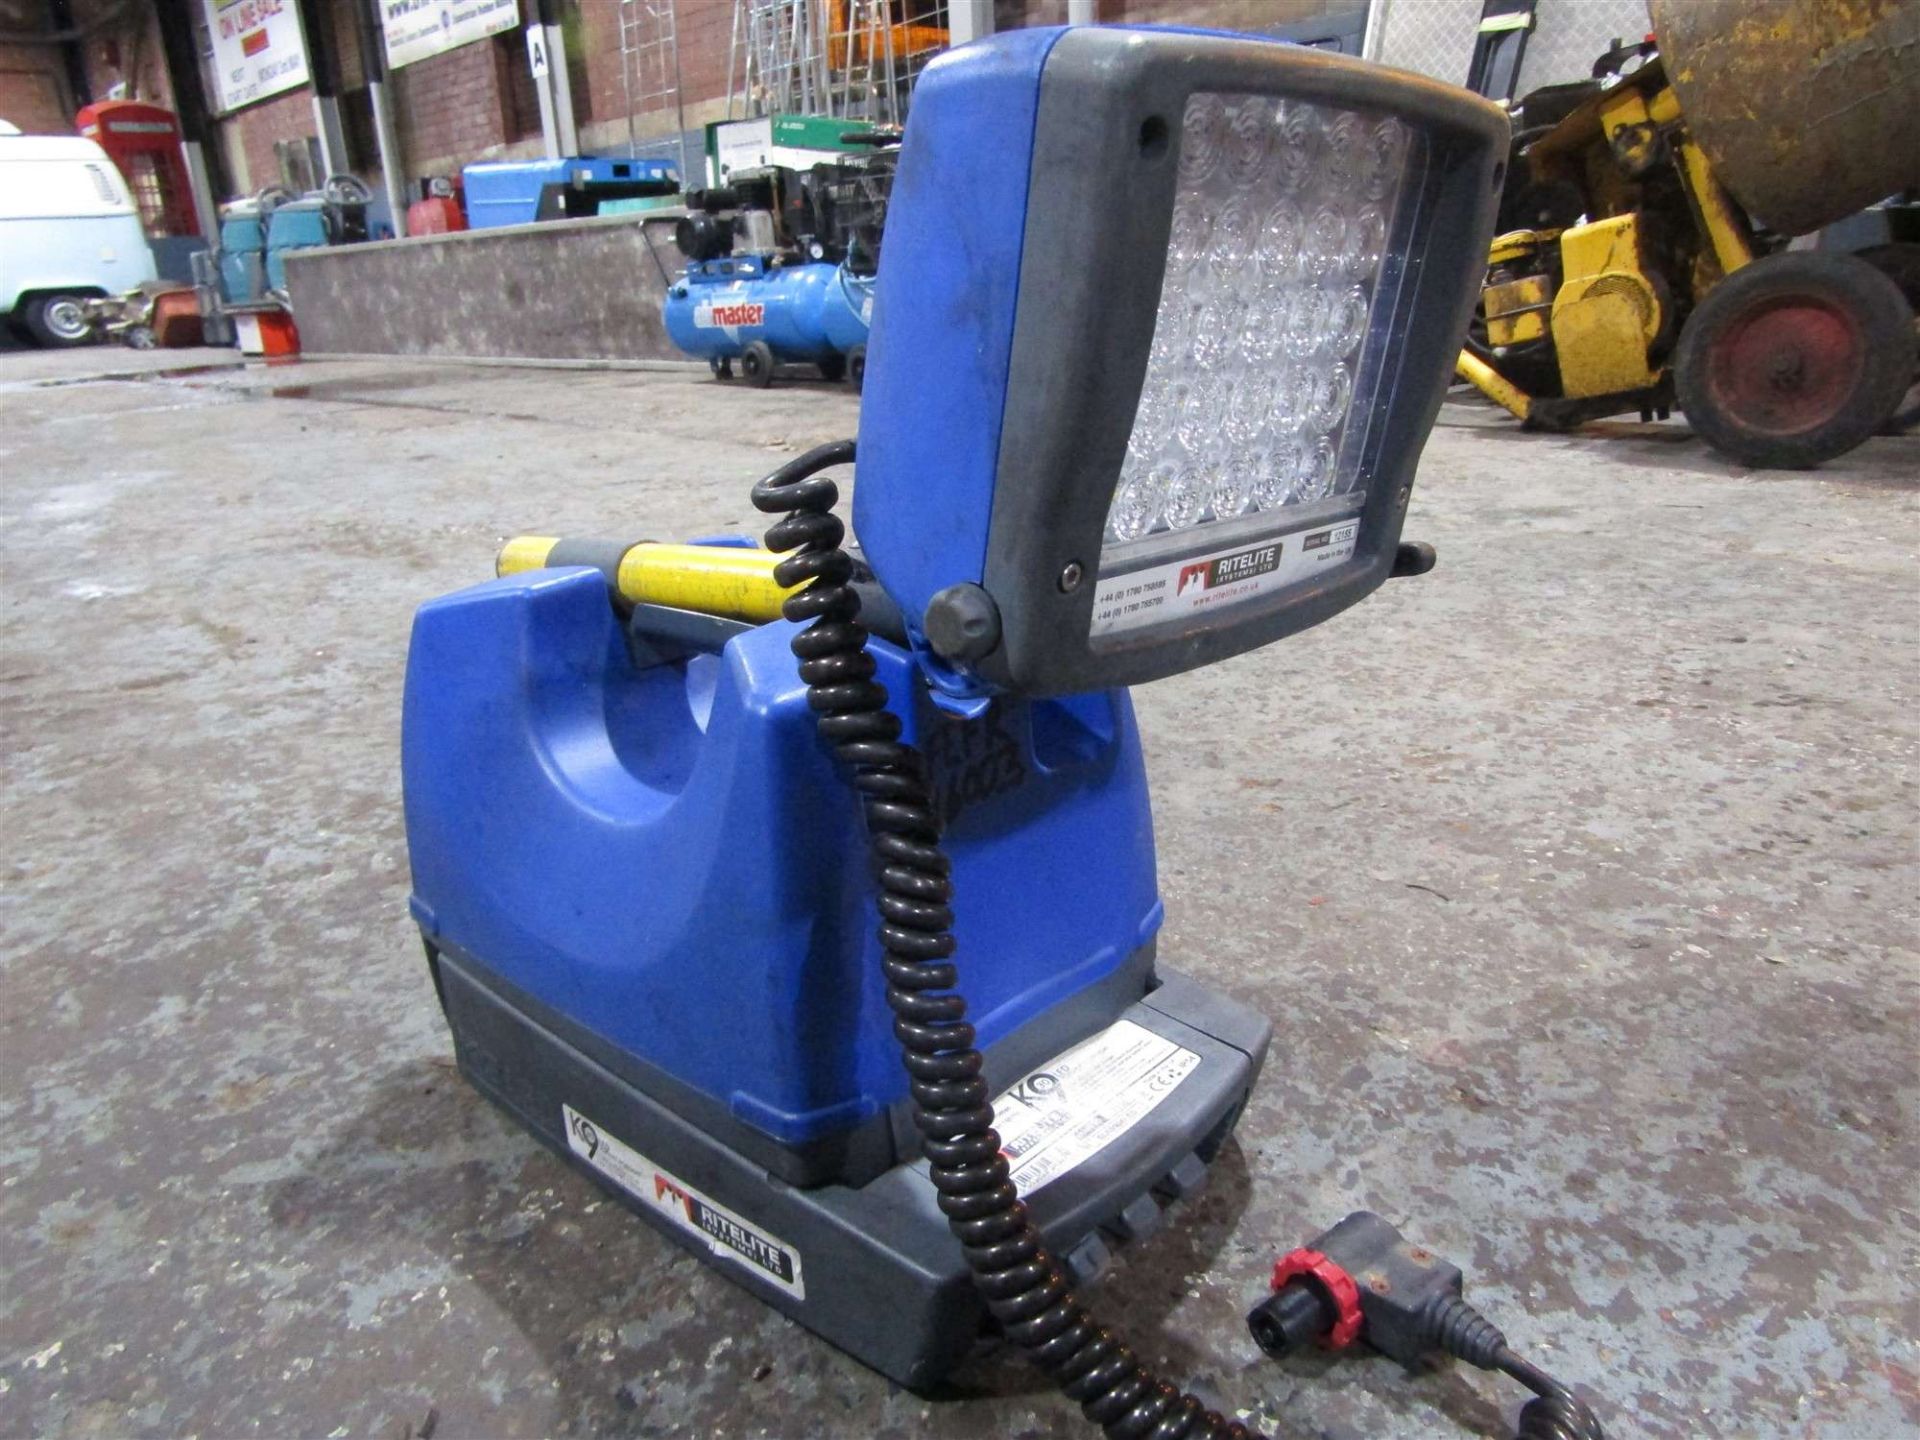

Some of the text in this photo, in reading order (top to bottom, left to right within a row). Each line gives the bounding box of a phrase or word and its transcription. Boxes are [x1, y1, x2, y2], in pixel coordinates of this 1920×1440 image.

[534, 43, 545, 67] A
[1218, 547, 1275, 575] RITELITE
[1259, 562, 1273, 573] LTD
[1100, 593, 1114, 602] +44
[1193, 582, 1259, 607] www.ritelite.co.uk
[1098, 610, 1112, 620] +44
[570, 1111, 598, 1160] K9
[701, 1206, 781, 1265] RITELITE
[763, 1258, 782, 1274] LTD
